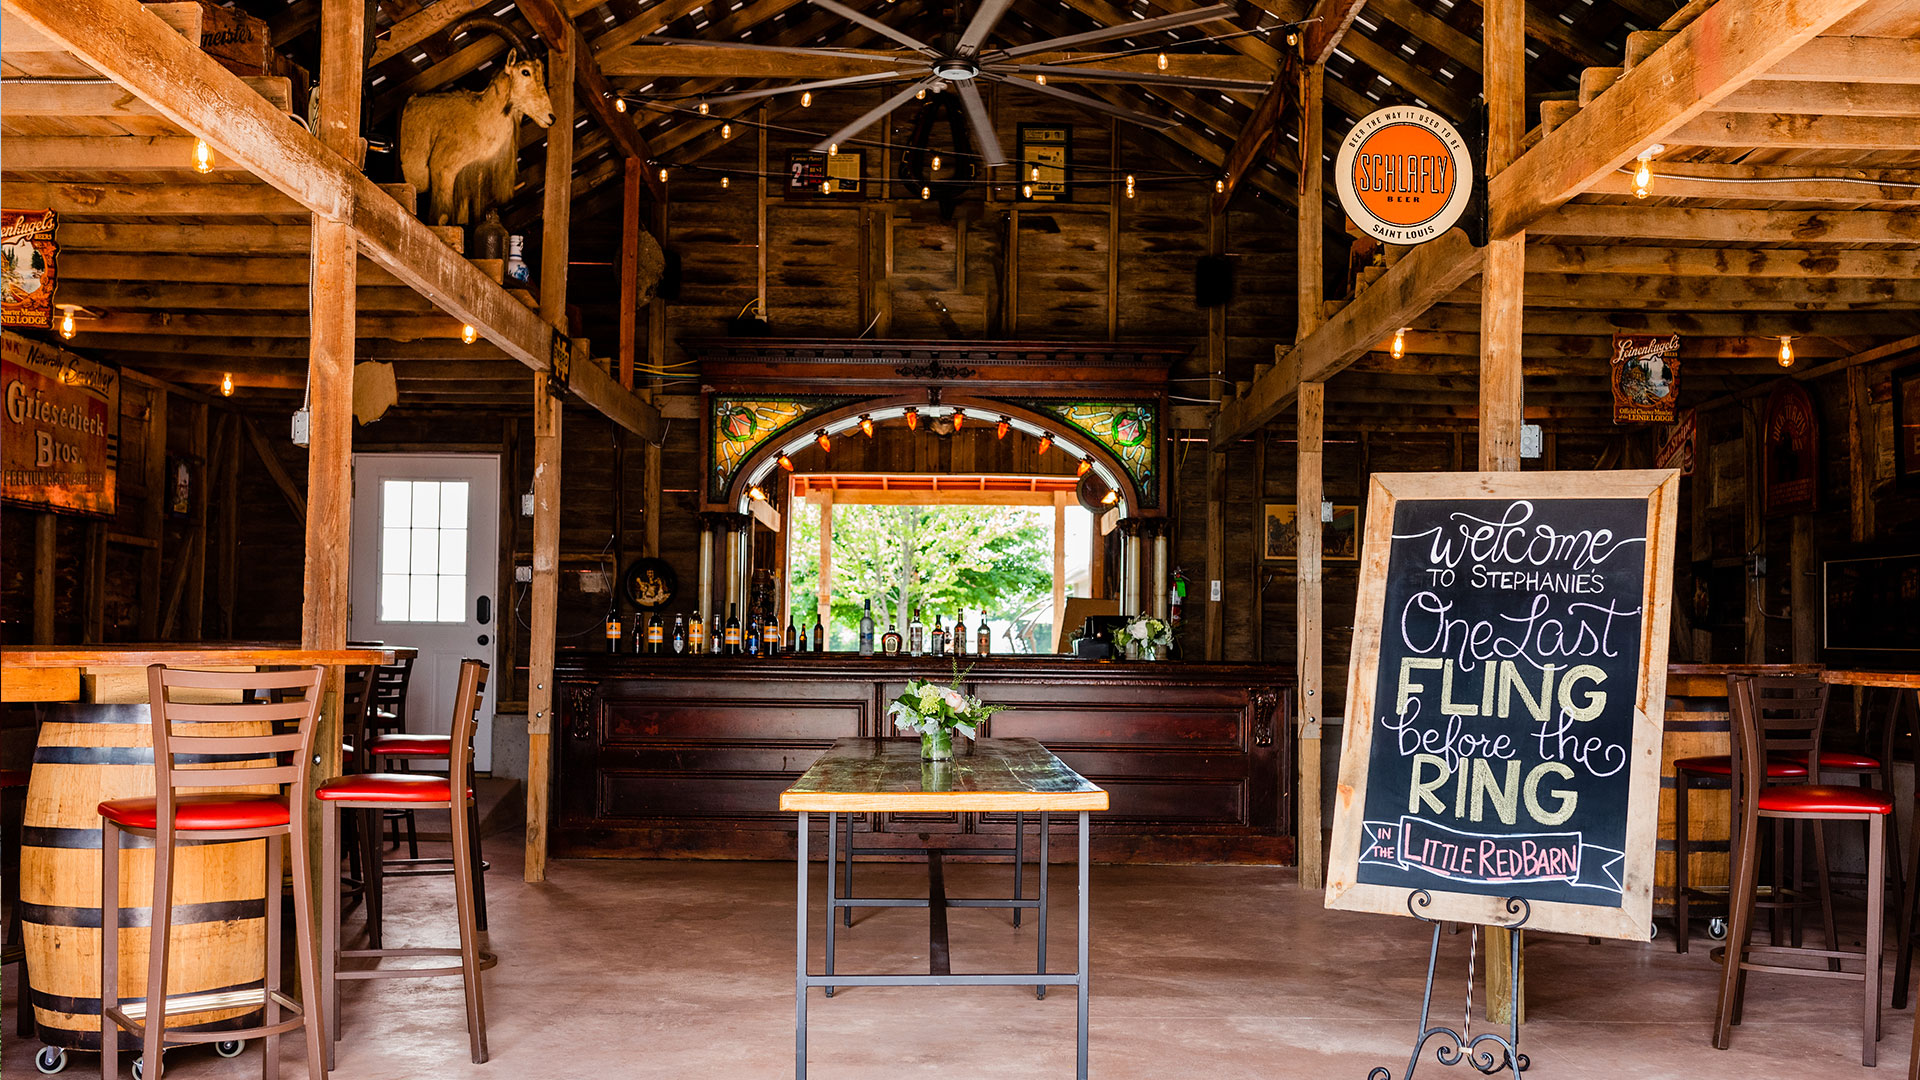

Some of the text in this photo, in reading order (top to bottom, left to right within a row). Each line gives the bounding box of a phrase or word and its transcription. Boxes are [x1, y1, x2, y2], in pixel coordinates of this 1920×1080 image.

[1348, 111, 1461, 151] BEER THE WAY IT USED TO BE
[1359, 153, 1448, 194] SCHLAFLY
[1372, 223, 1435, 240] SAINT LOUIS
[16, 316, 47, 325] LODGE
[6, 379, 104, 437] Griesedieck
[35, 429, 83, 468] Bros.
[4, 470, 44, 486] PREMIUM
[1426, 564, 1605, 594] TO STEPHANIE'S
[1401, 591, 1642, 672] One Last
[1396, 657, 1608, 722] FLING
[1381, 697, 1626, 777] before the
[1408, 753, 1578, 826] RING
[1373, 846, 1395, 859] THE
[1377, 828, 1392, 840] IN
[1403, 823, 1473, 875] LITTLE
